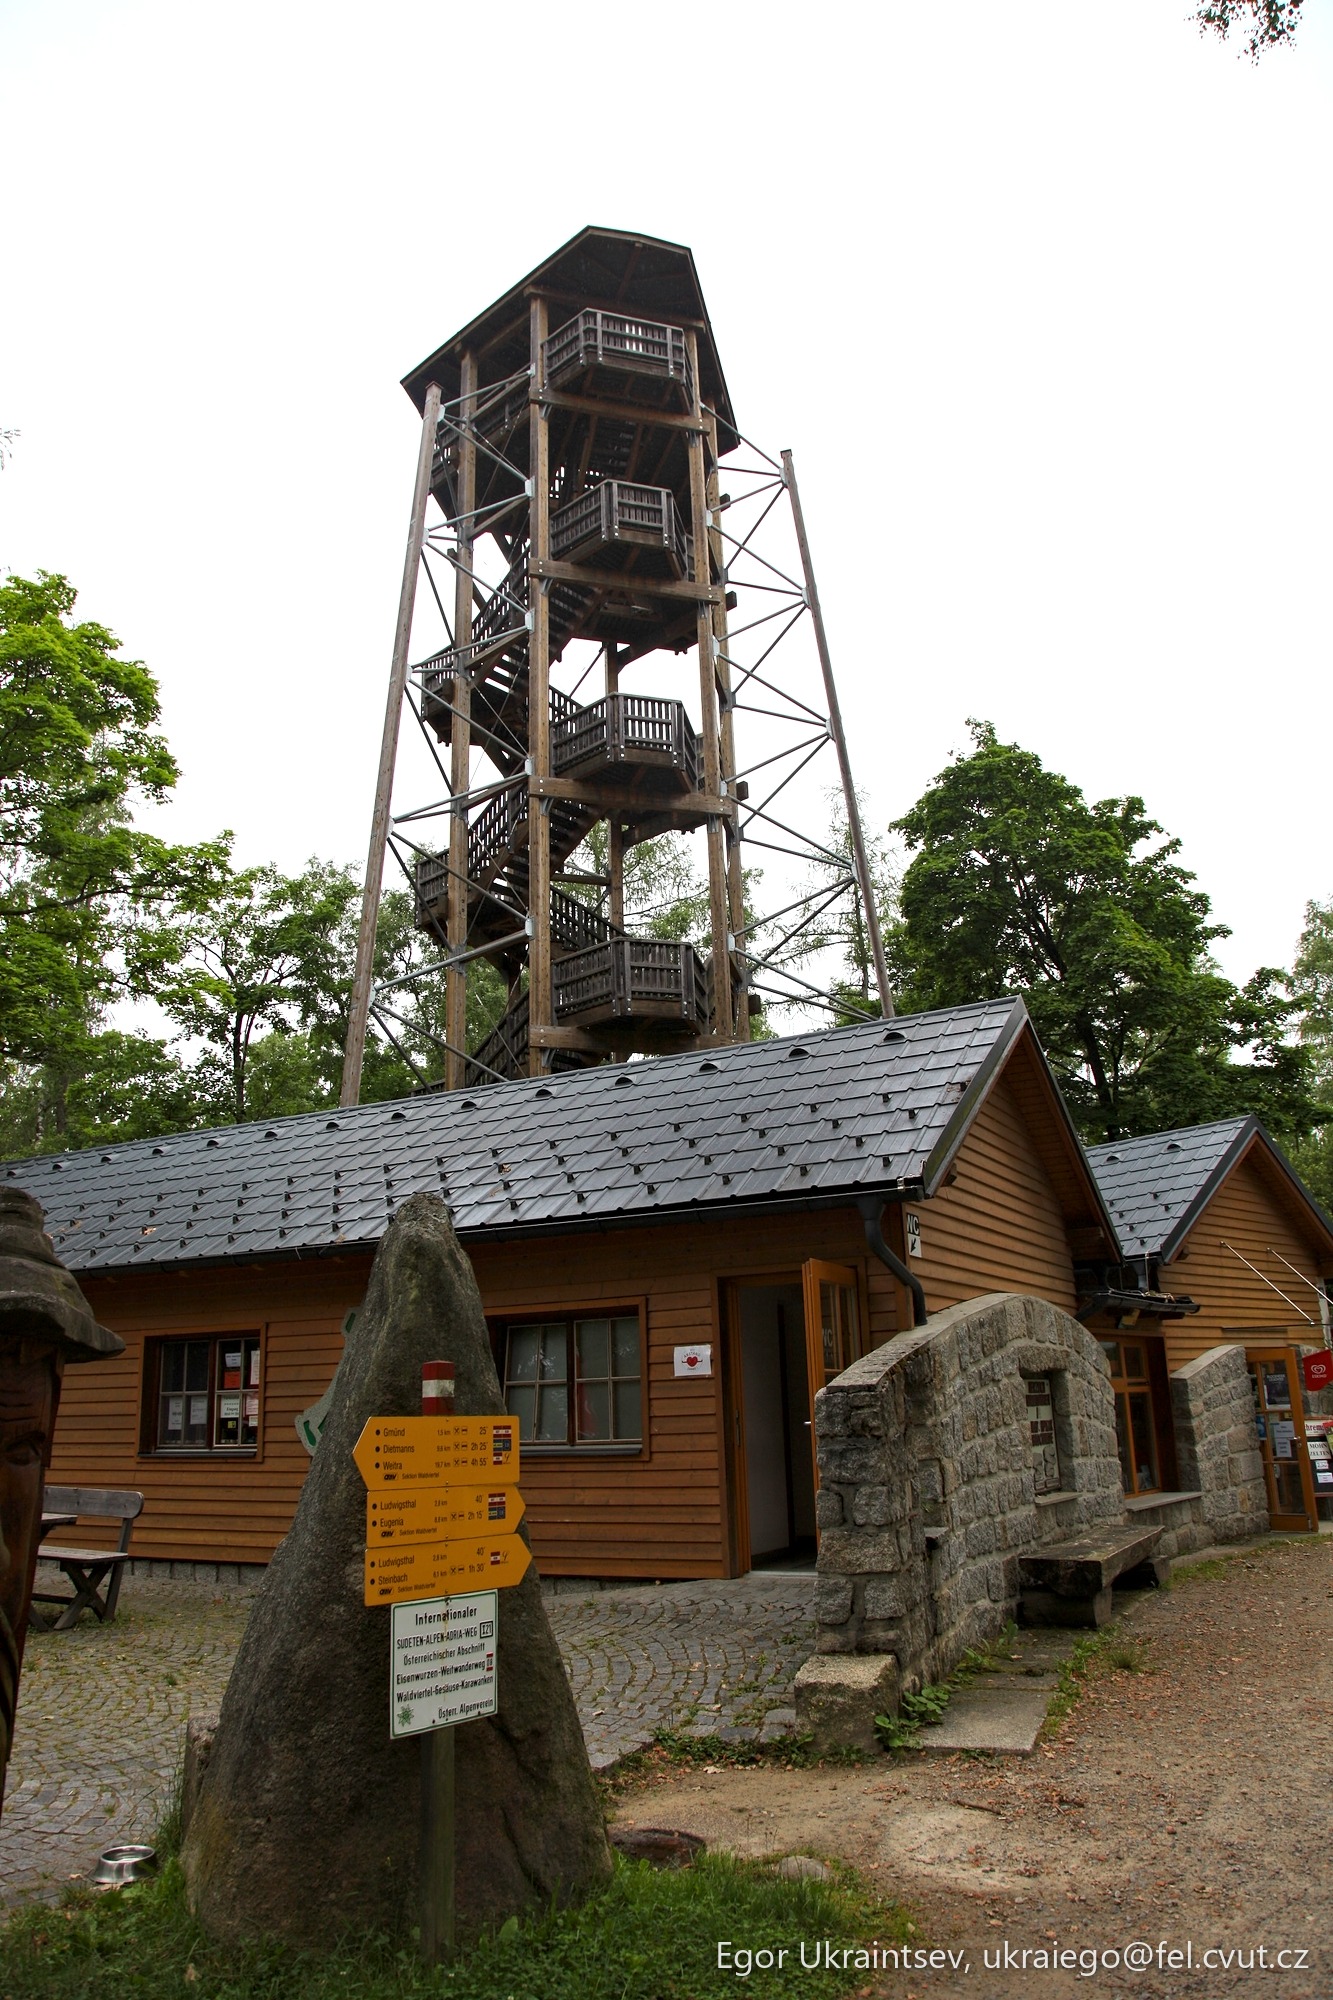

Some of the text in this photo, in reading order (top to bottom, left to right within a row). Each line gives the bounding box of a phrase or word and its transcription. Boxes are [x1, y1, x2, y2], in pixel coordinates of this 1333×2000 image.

[383, 1427, 406, 1437] Gmünd
[383, 1444, 415, 1454] Dietmanns
[470, 1442, 479, 1451] 2h
[382, 1461, 403, 1471] Weitra
[470, 1458, 479, 1467] 4h
[380, 1499, 417, 1511] Ludwigsthal
[468, 1511, 476, 1520] 2h
[380, 1517, 404, 1529] Eugenia
[399, 1529, 415, 1537] Sektion
[378, 1555, 415, 1568] Ludwigsthal
[468, 1564, 476, 1573] 1h
[378, 1573, 408, 1586] Steinbach
[397, 1585, 413, 1594] Sektion
[415, 1606, 478, 1626] Internationaler
[397, 1627, 478, 1649] SUDETEN-ALPEN-ADRIA-WEG
[403, 1642, 486, 1666] Österreichischer Abschnitt
[396, 1660, 486, 1685] Eisenwurzen-Weitwanderweg
[396, 1675, 494, 1703] Waldviertel-Gesäuse-Karawanken
[459, 1698, 494, 1715] Alpenverein
